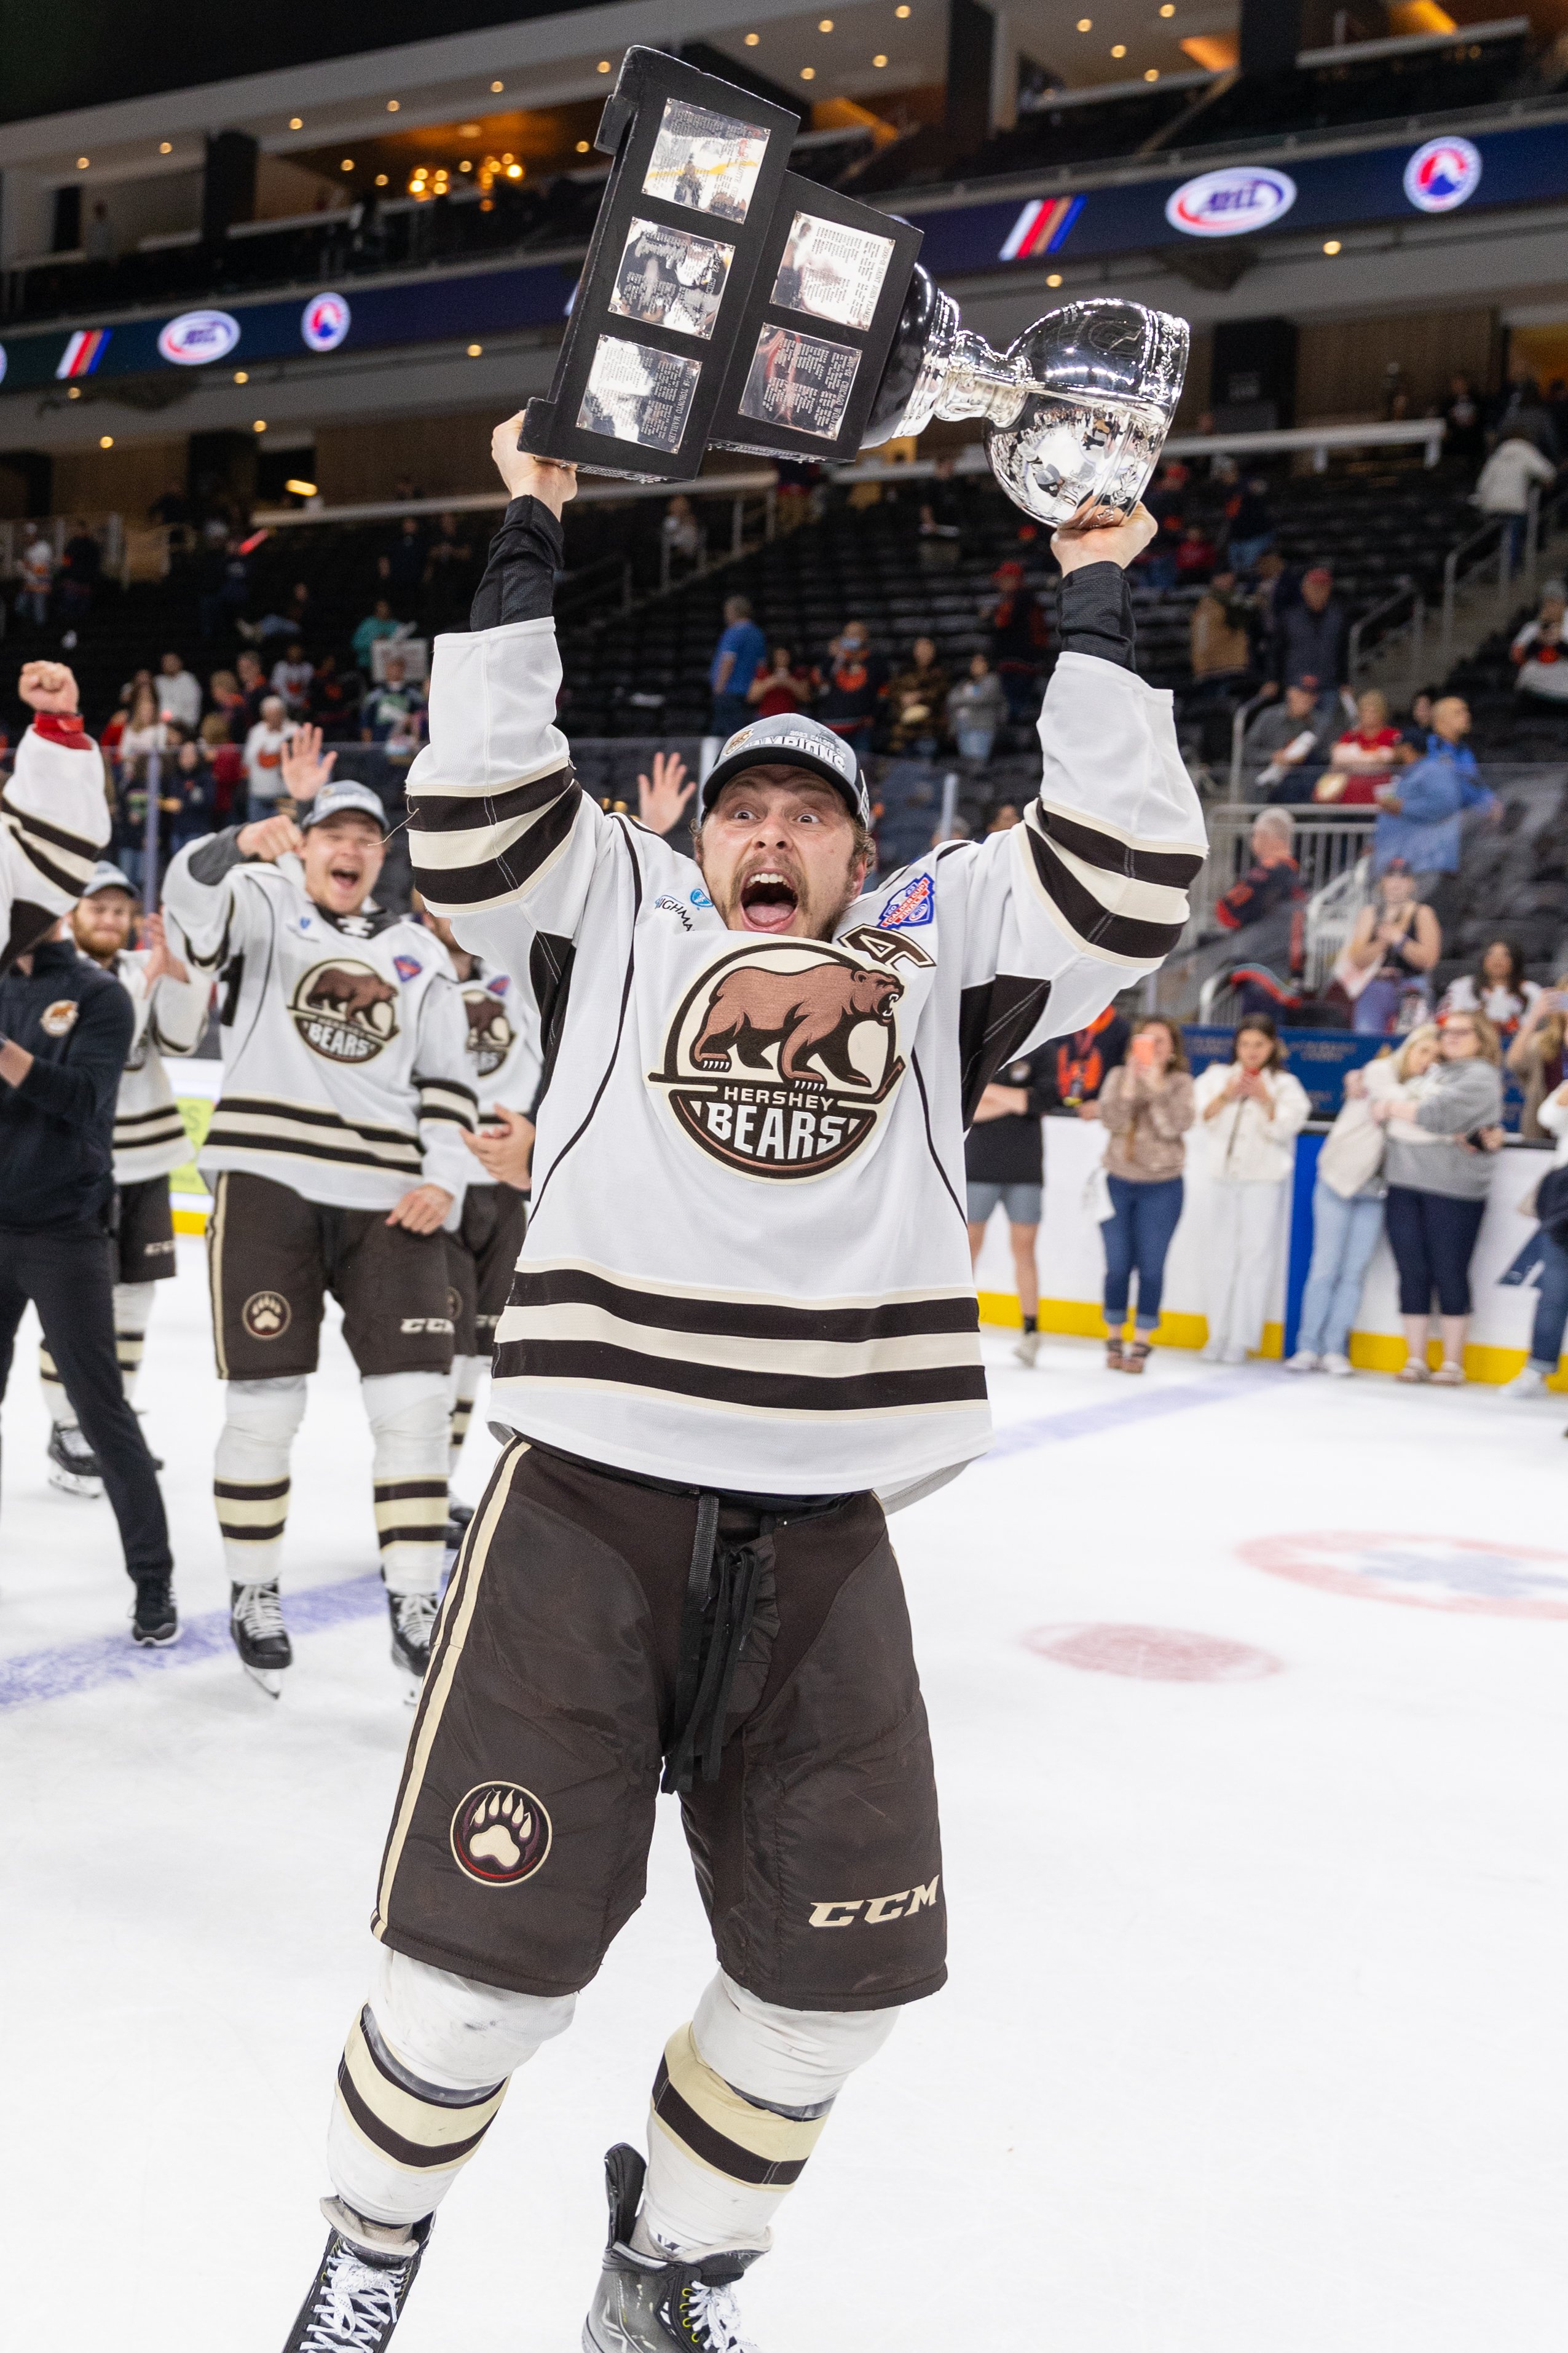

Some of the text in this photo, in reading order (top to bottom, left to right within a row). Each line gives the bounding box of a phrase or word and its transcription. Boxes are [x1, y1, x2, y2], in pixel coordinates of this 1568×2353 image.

[862, 245, 890, 322] 2000-01 SAINT JOHN FLAMES
[682, 366, 694, 387] 2017-18
[843, 356, 856, 376] 2001-02
[674, 387, 688, 414] TORONTO
[835, 380, 849, 406] CHICAGO
[666, 414, 681, 443] MARLIES
[828, 407, 841, 431] WOLVES
[810, 735, 835, 751] CALDER
[888, 883, 926, 923] CALDER CUP
[899, 893, 926, 919] FINALS
[309, 1022, 369, 1057] BEARS
[724, 1087, 835, 1111] HERSHEY
[706, 1101, 847, 1160] BEARS
[808, 1874, 940, 1928] CCM
